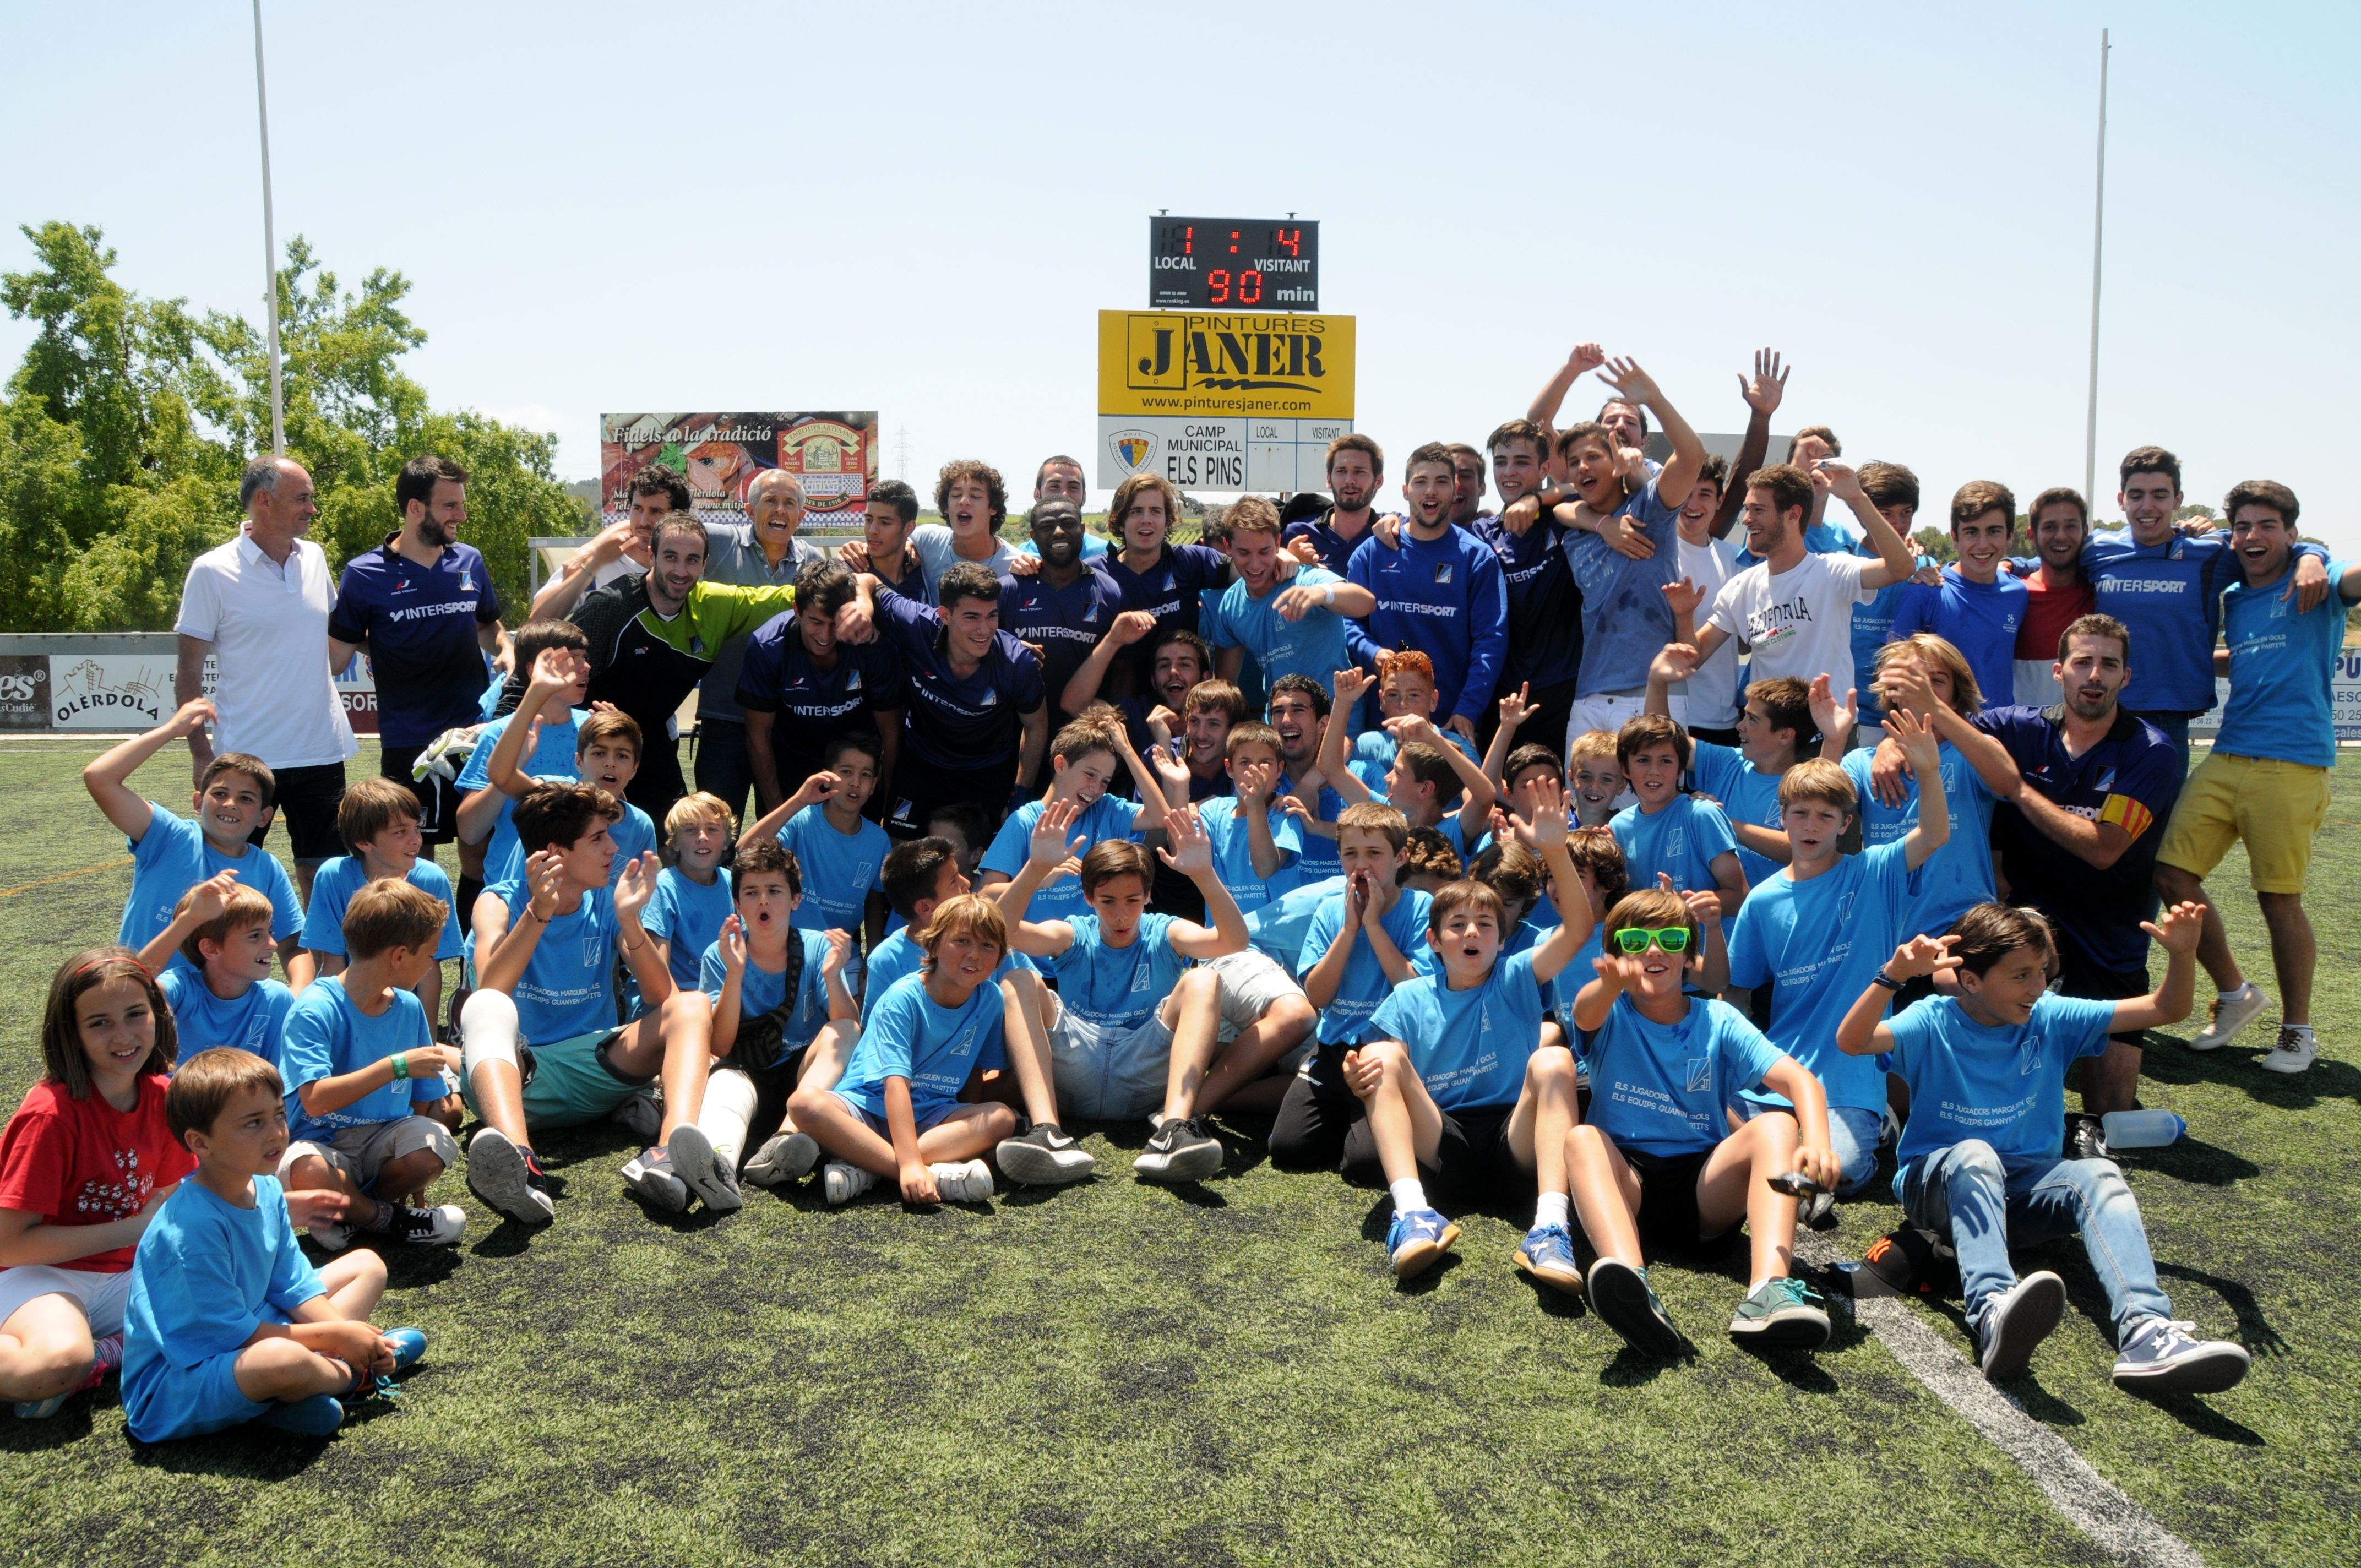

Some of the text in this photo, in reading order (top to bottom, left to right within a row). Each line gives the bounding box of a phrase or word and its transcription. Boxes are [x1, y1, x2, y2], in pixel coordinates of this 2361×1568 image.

[1278, 229, 1300, 257] 4
[1155, 257, 1196, 270] LOCAL
[1255, 259, 1310, 273] VISITANT
[1209, 269, 1315, 303] 90 min
[1189, 317, 1326, 333] PINTURES
[1138, 328, 1326, 377] JANER
[1142, 396, 1312, 412] www.pinturesjaner.com
[613, 425, 771, 443] Fidels a la tradició
[789, 424, 853, 439] EMBOTITS ARTESANS
[1185, 425, 1225, 438] CAMP
[1256, 426, 1278, 438] LOCAL
[1312, 427, 1340, 439] VISITANT
[1168, 439, 1242, 451] MUNICIPAL
[1168, 456, 1242, 486] ELS PINS
[698, 502, 746, 511] www.mitja
[2102, 580, 2186, 593] INTERSPORT
[406, 601, 477, 620] INTERSPORT
[1391, 601, 1457, 617] INTERSPORT
[1028, 627, 1097, 644] INTERSPORT
[58, 693, 158, 721] OLÈRDOLA
[156, 913, 168, 923] ELS
[161, 906, 173, 914] ELS
[527, 993, 550, 1004] EQUIPS
[529, 984, 559, 997] JUGADORS
[1427, 1052, 1496, 1083] JUGADORS GOLS
[948, 1076, 966, 1085] GOLS
[1427, 1082, 1449, 1092] EQUIPS
[1473, 1061, 1498, 1075] PARTITS
[1614, 1081, 1628, 1091] ELS
[1630, 1085, 1670, 1102] JUGADORS
[1612, 1092, 1626, 1102] ELS
[1627, 1096, 1656, 1110] EQUIPS
[1941, 1101, 1954, 1109] ELS
[1955, 1104, 1990, 1115] JUGADORS
[1992, 1099, 2025, 1115] MARQUEN
[1939, 1111, 1952, 1120] ELS
[1955, 1114, 1982, 1126] EQUIPS
